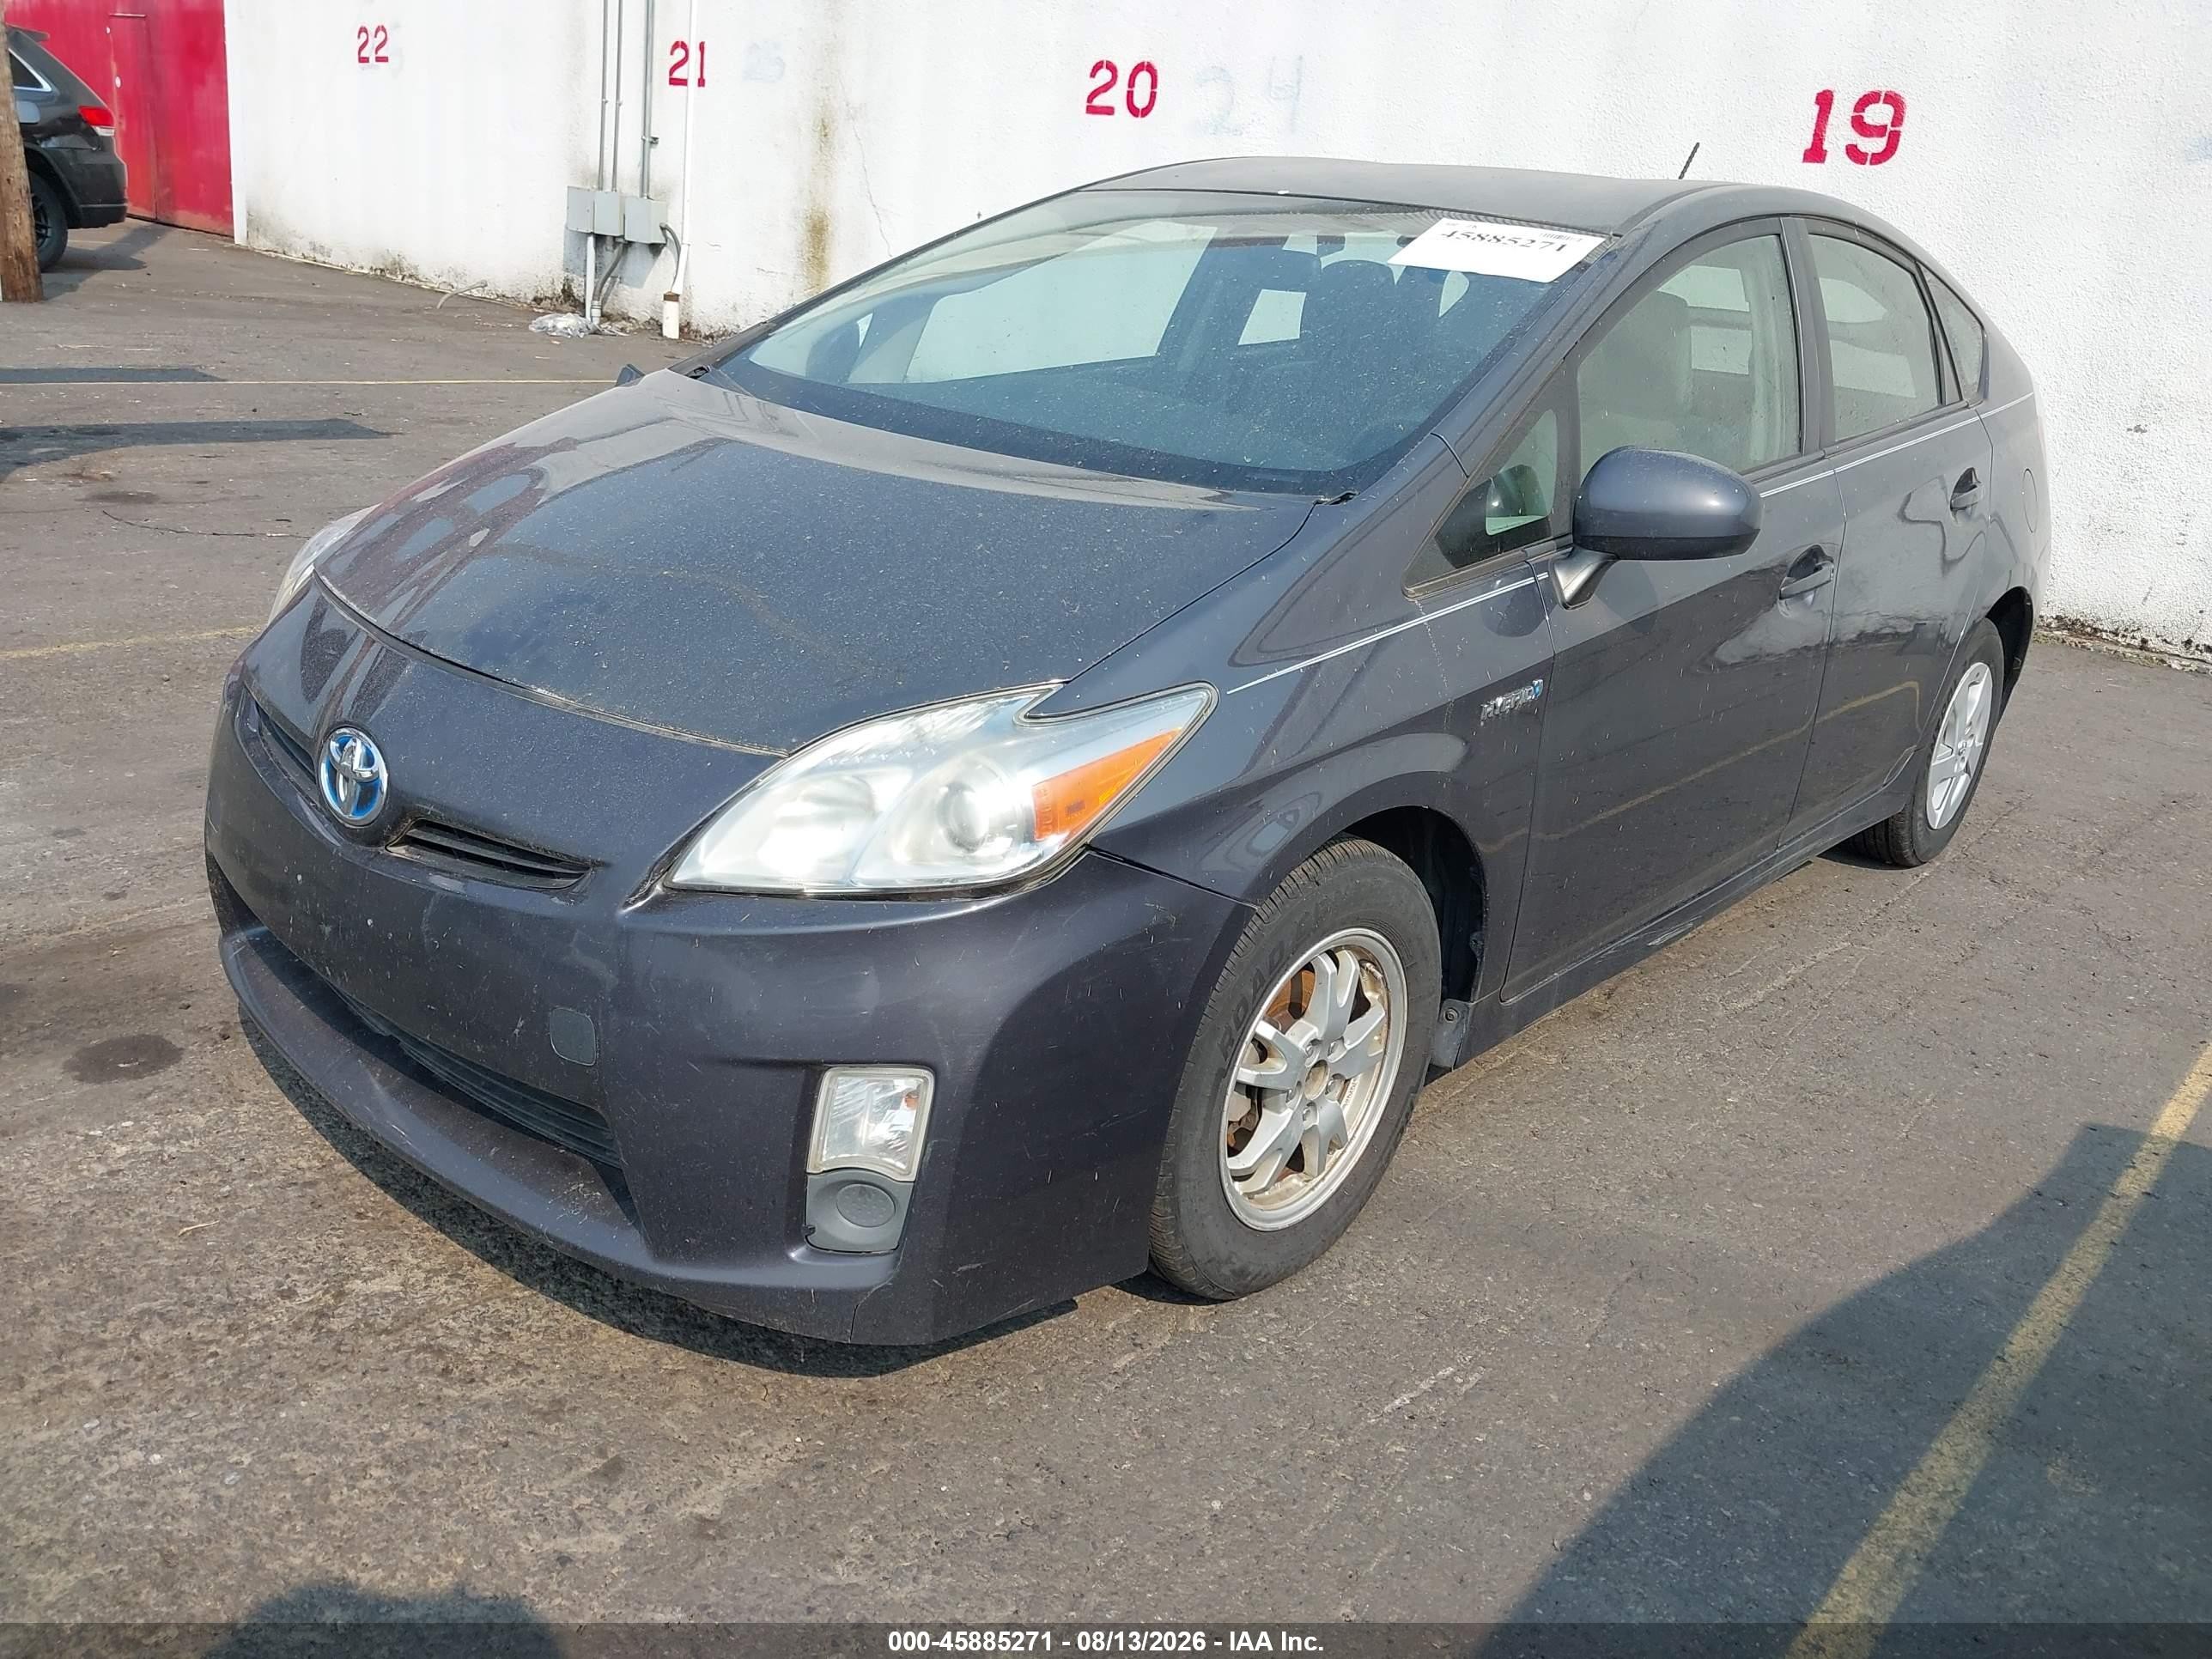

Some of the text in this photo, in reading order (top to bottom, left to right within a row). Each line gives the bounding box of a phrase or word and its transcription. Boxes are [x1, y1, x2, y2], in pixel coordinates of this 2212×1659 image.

[357, 26, 388, 63] 22
[668, 40, 706, 88] 21
[1085, 60, 1158, 118] 20
[1802, 89, 1906, 165] 19
